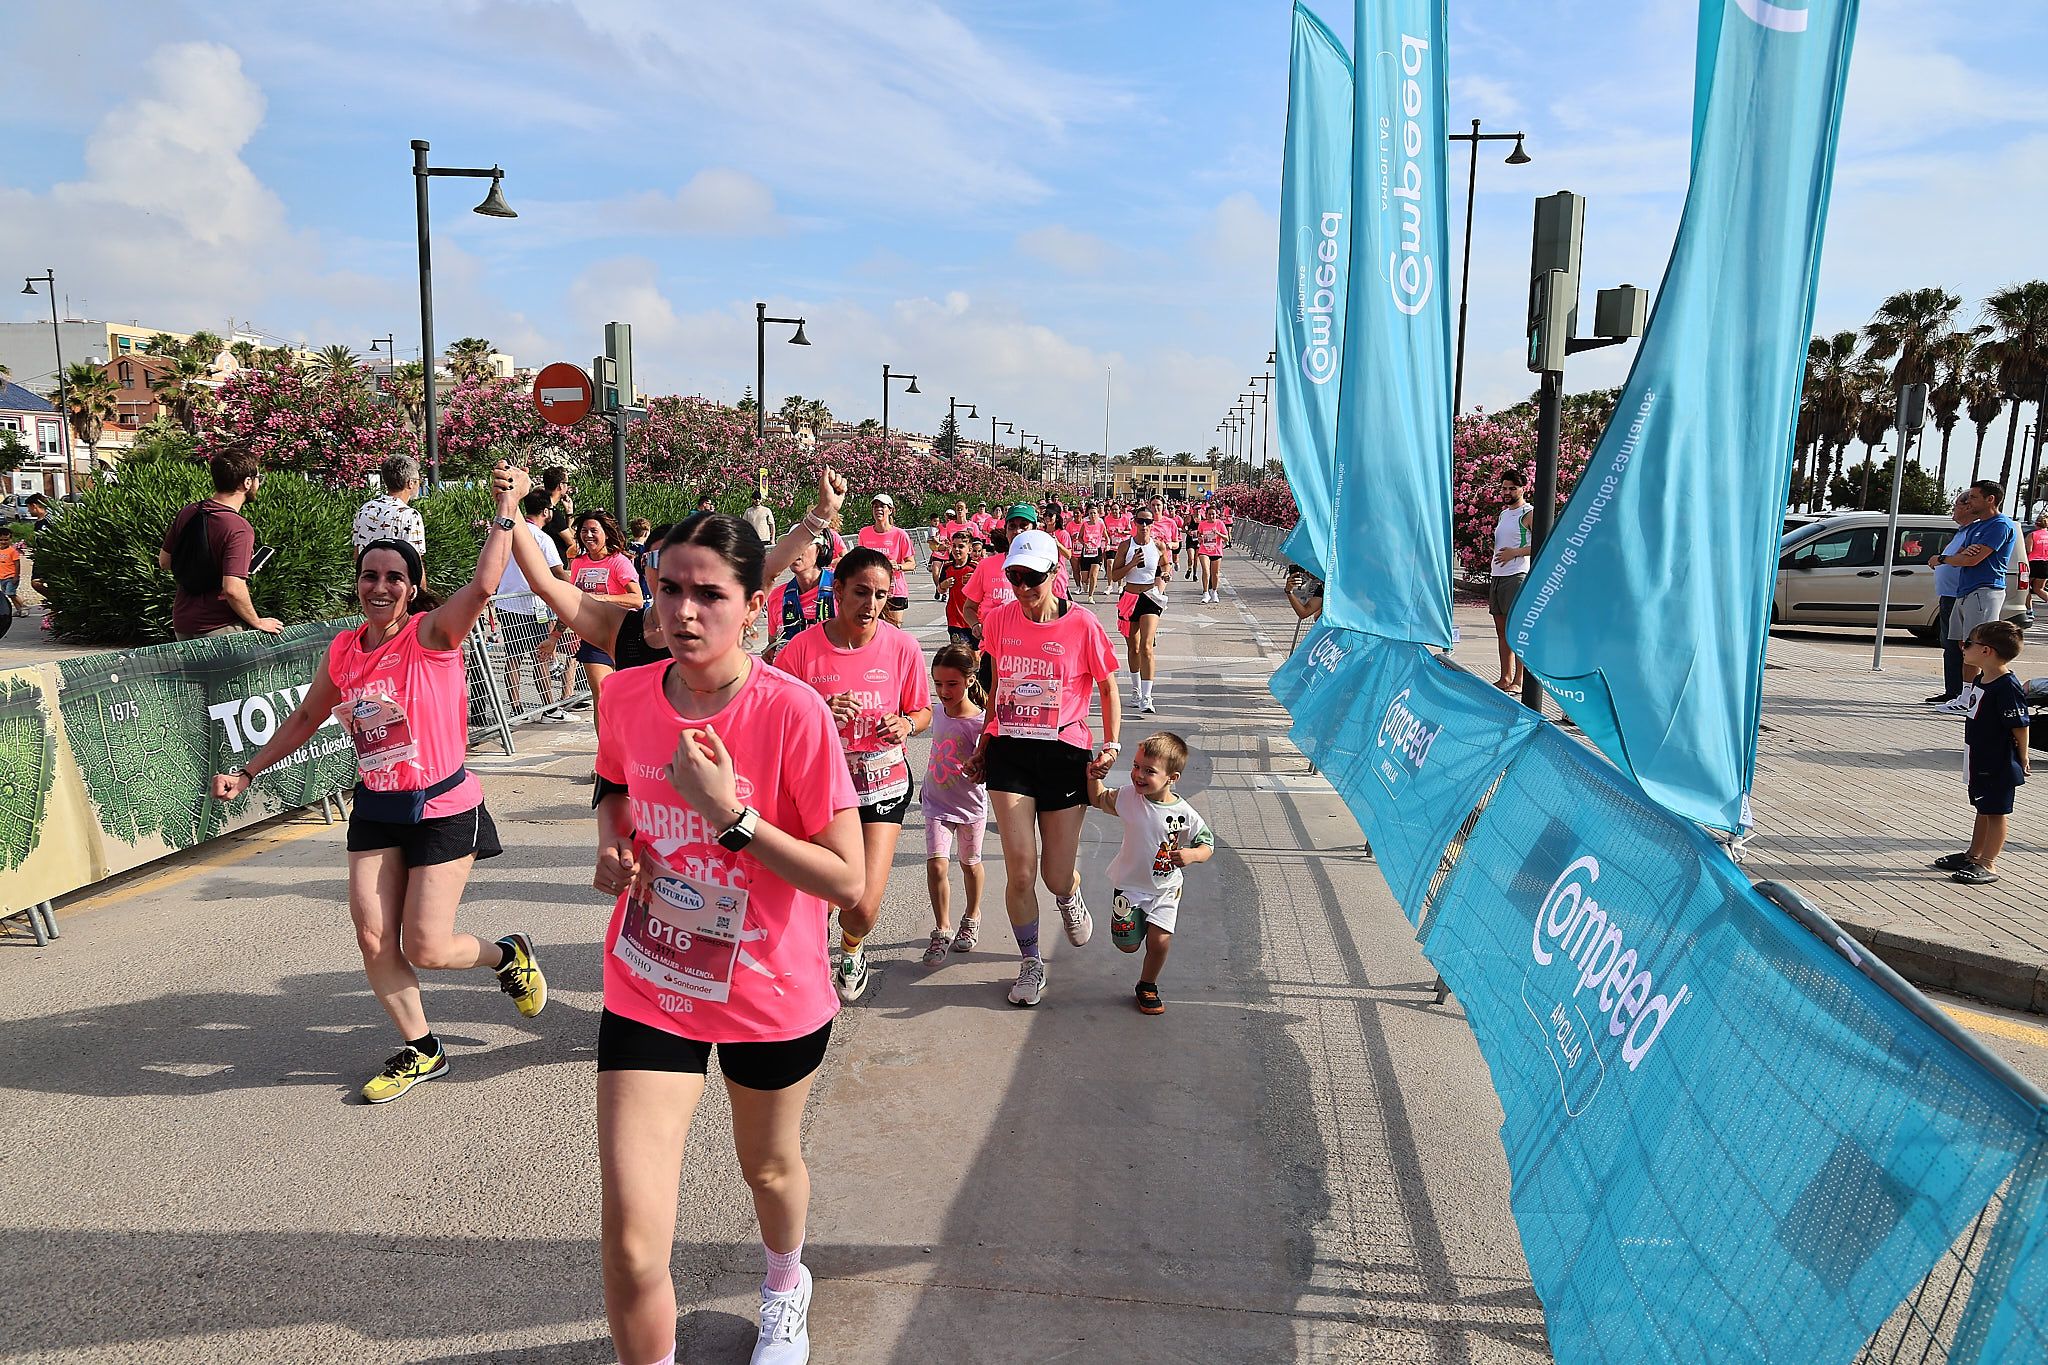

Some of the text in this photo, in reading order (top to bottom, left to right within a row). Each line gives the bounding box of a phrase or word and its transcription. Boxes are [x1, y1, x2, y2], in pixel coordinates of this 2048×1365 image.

[992, 587, 1018, 601] CARR
[999, 655, 1054, 677] CARRERA
[810, 674, 840, 684] OYSHO
[109, 700, 140, 722] 1975
[1015, 705, 1040, 716] 016
[365, 726, 388, 743] 016
[1377, 688, 1443, 769] Compeed
[291, 746, 309, 765] de
[308, 741, 321, 759] ti
[321, 732, 354, 755] desde
[867, 767, 891, 782] 016
[630, 797, 719, 845] CARRE
[655, 880, 700, 908] ASTURIANA
[647, 917, 692, 951] 016
[625, 947, 652, 973] OYSHO
[644, 948, 652, 957] DE
[651, 952, 660, 961] LA
[660, 956, 680, 970] MUJER
[684, 966, 715, 980] VALENCIA
[1532, 855, 1688, 1072] Compeed
[672, 977, 713, 994] Santander
[657, 993, 694, 1013] 2026
